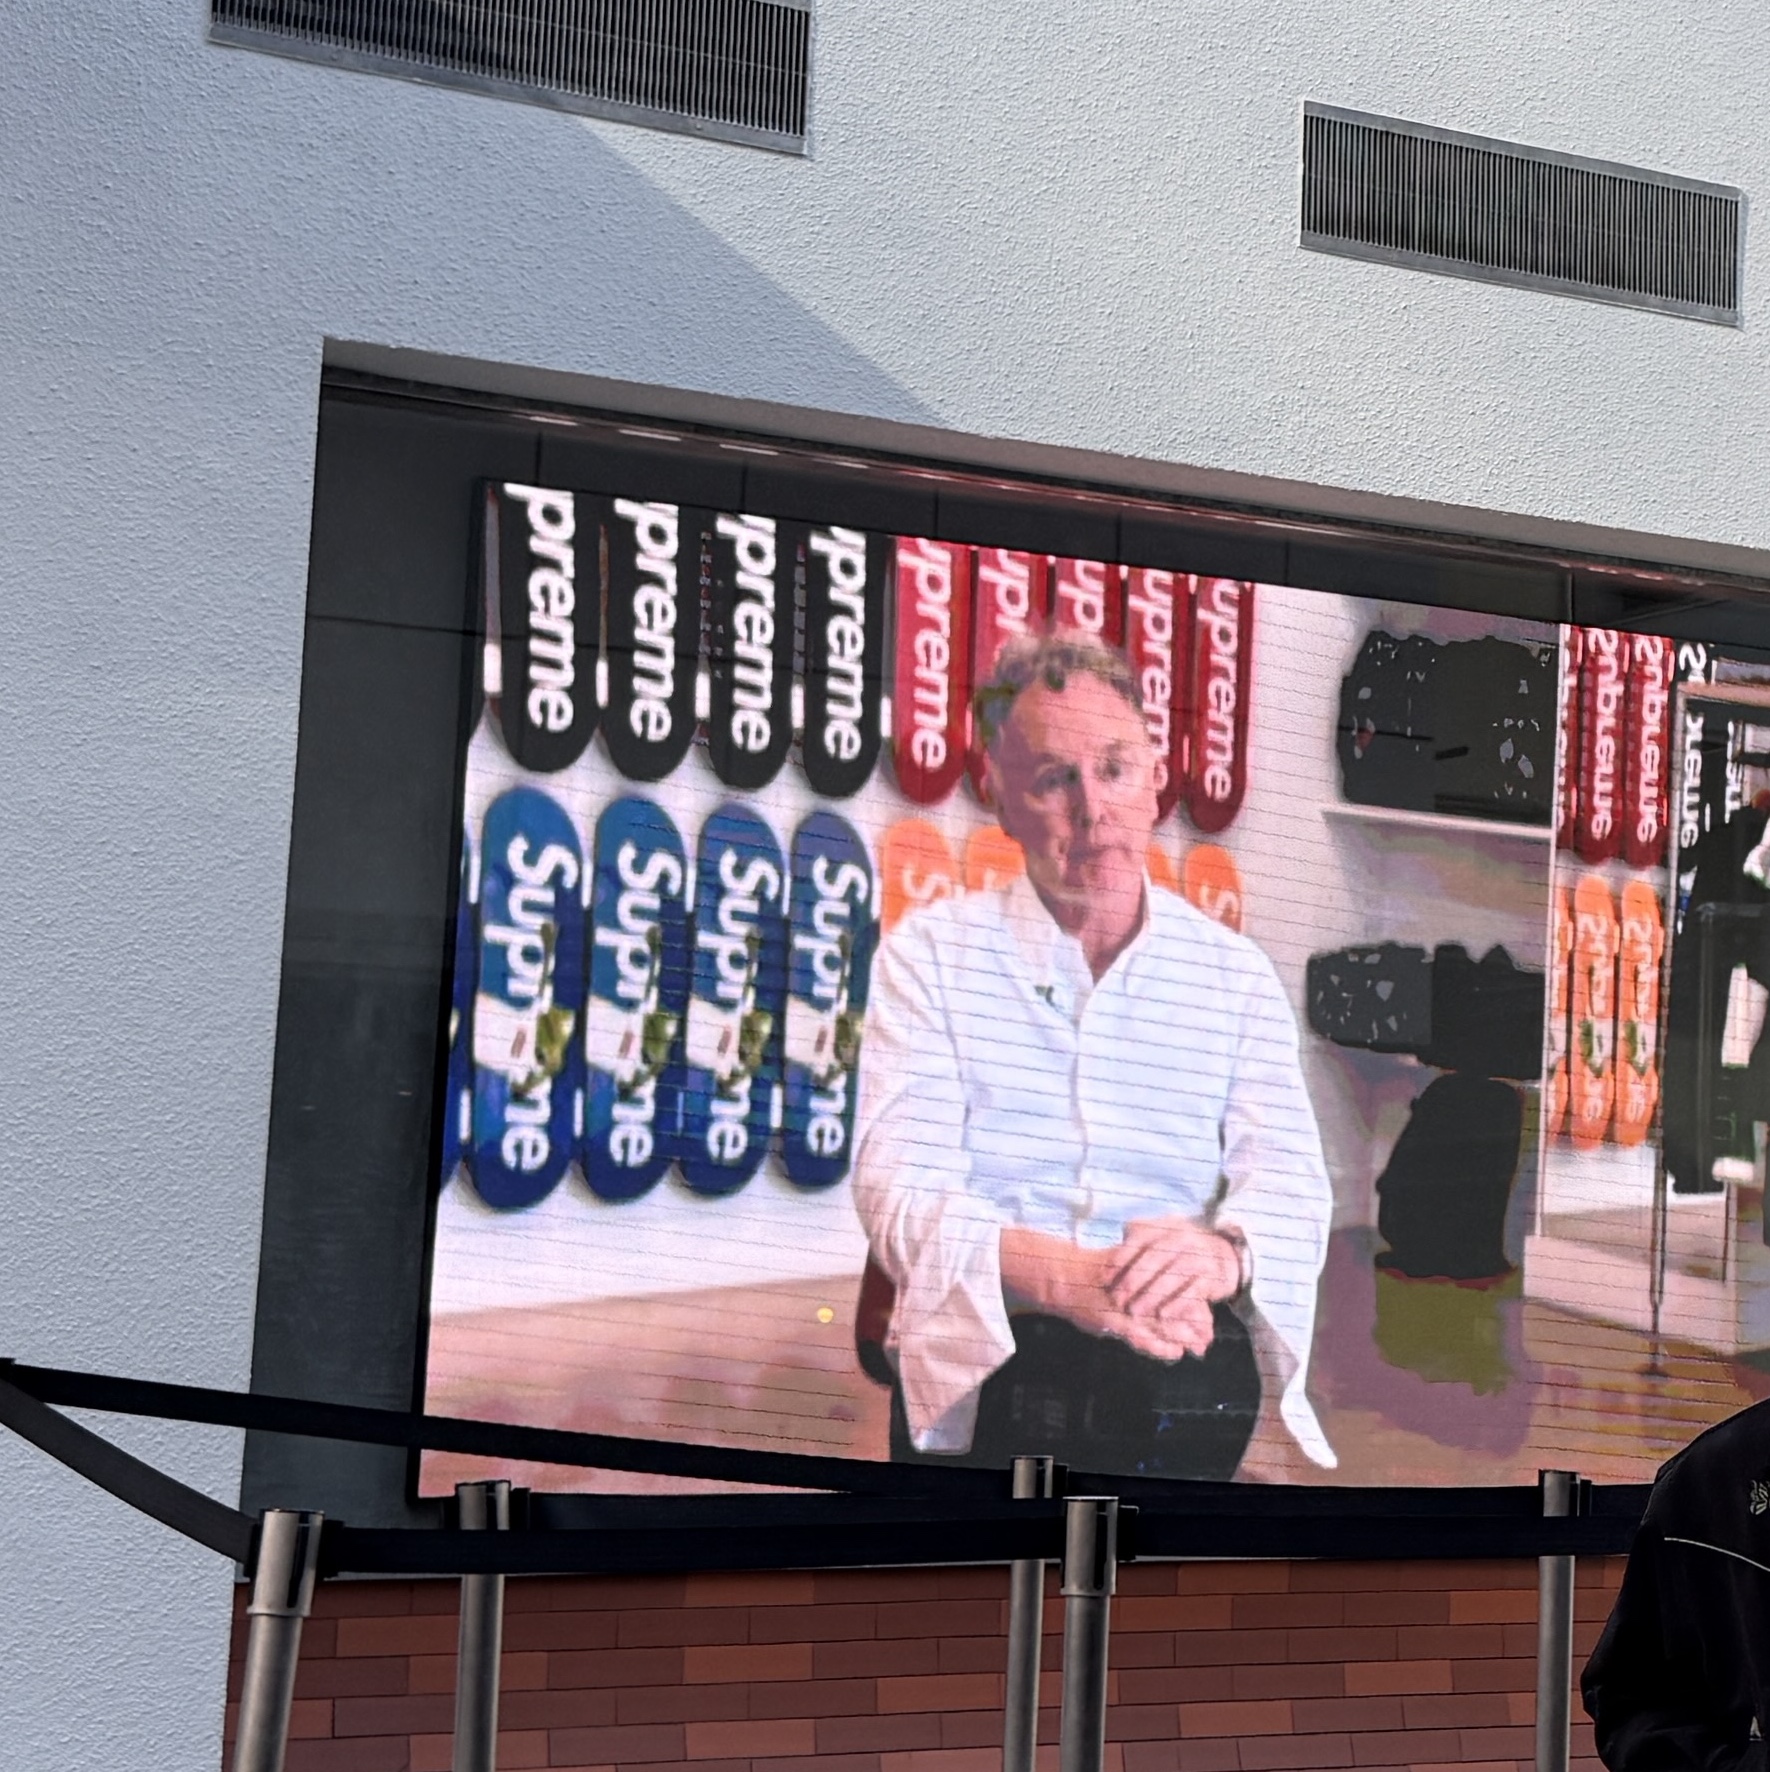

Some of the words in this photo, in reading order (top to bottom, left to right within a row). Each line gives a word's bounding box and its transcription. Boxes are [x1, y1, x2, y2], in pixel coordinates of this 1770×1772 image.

[614, 498, 679, 742] preme
[716, 512, 776, 753] preme
[809, 526, 866, 761] preme
